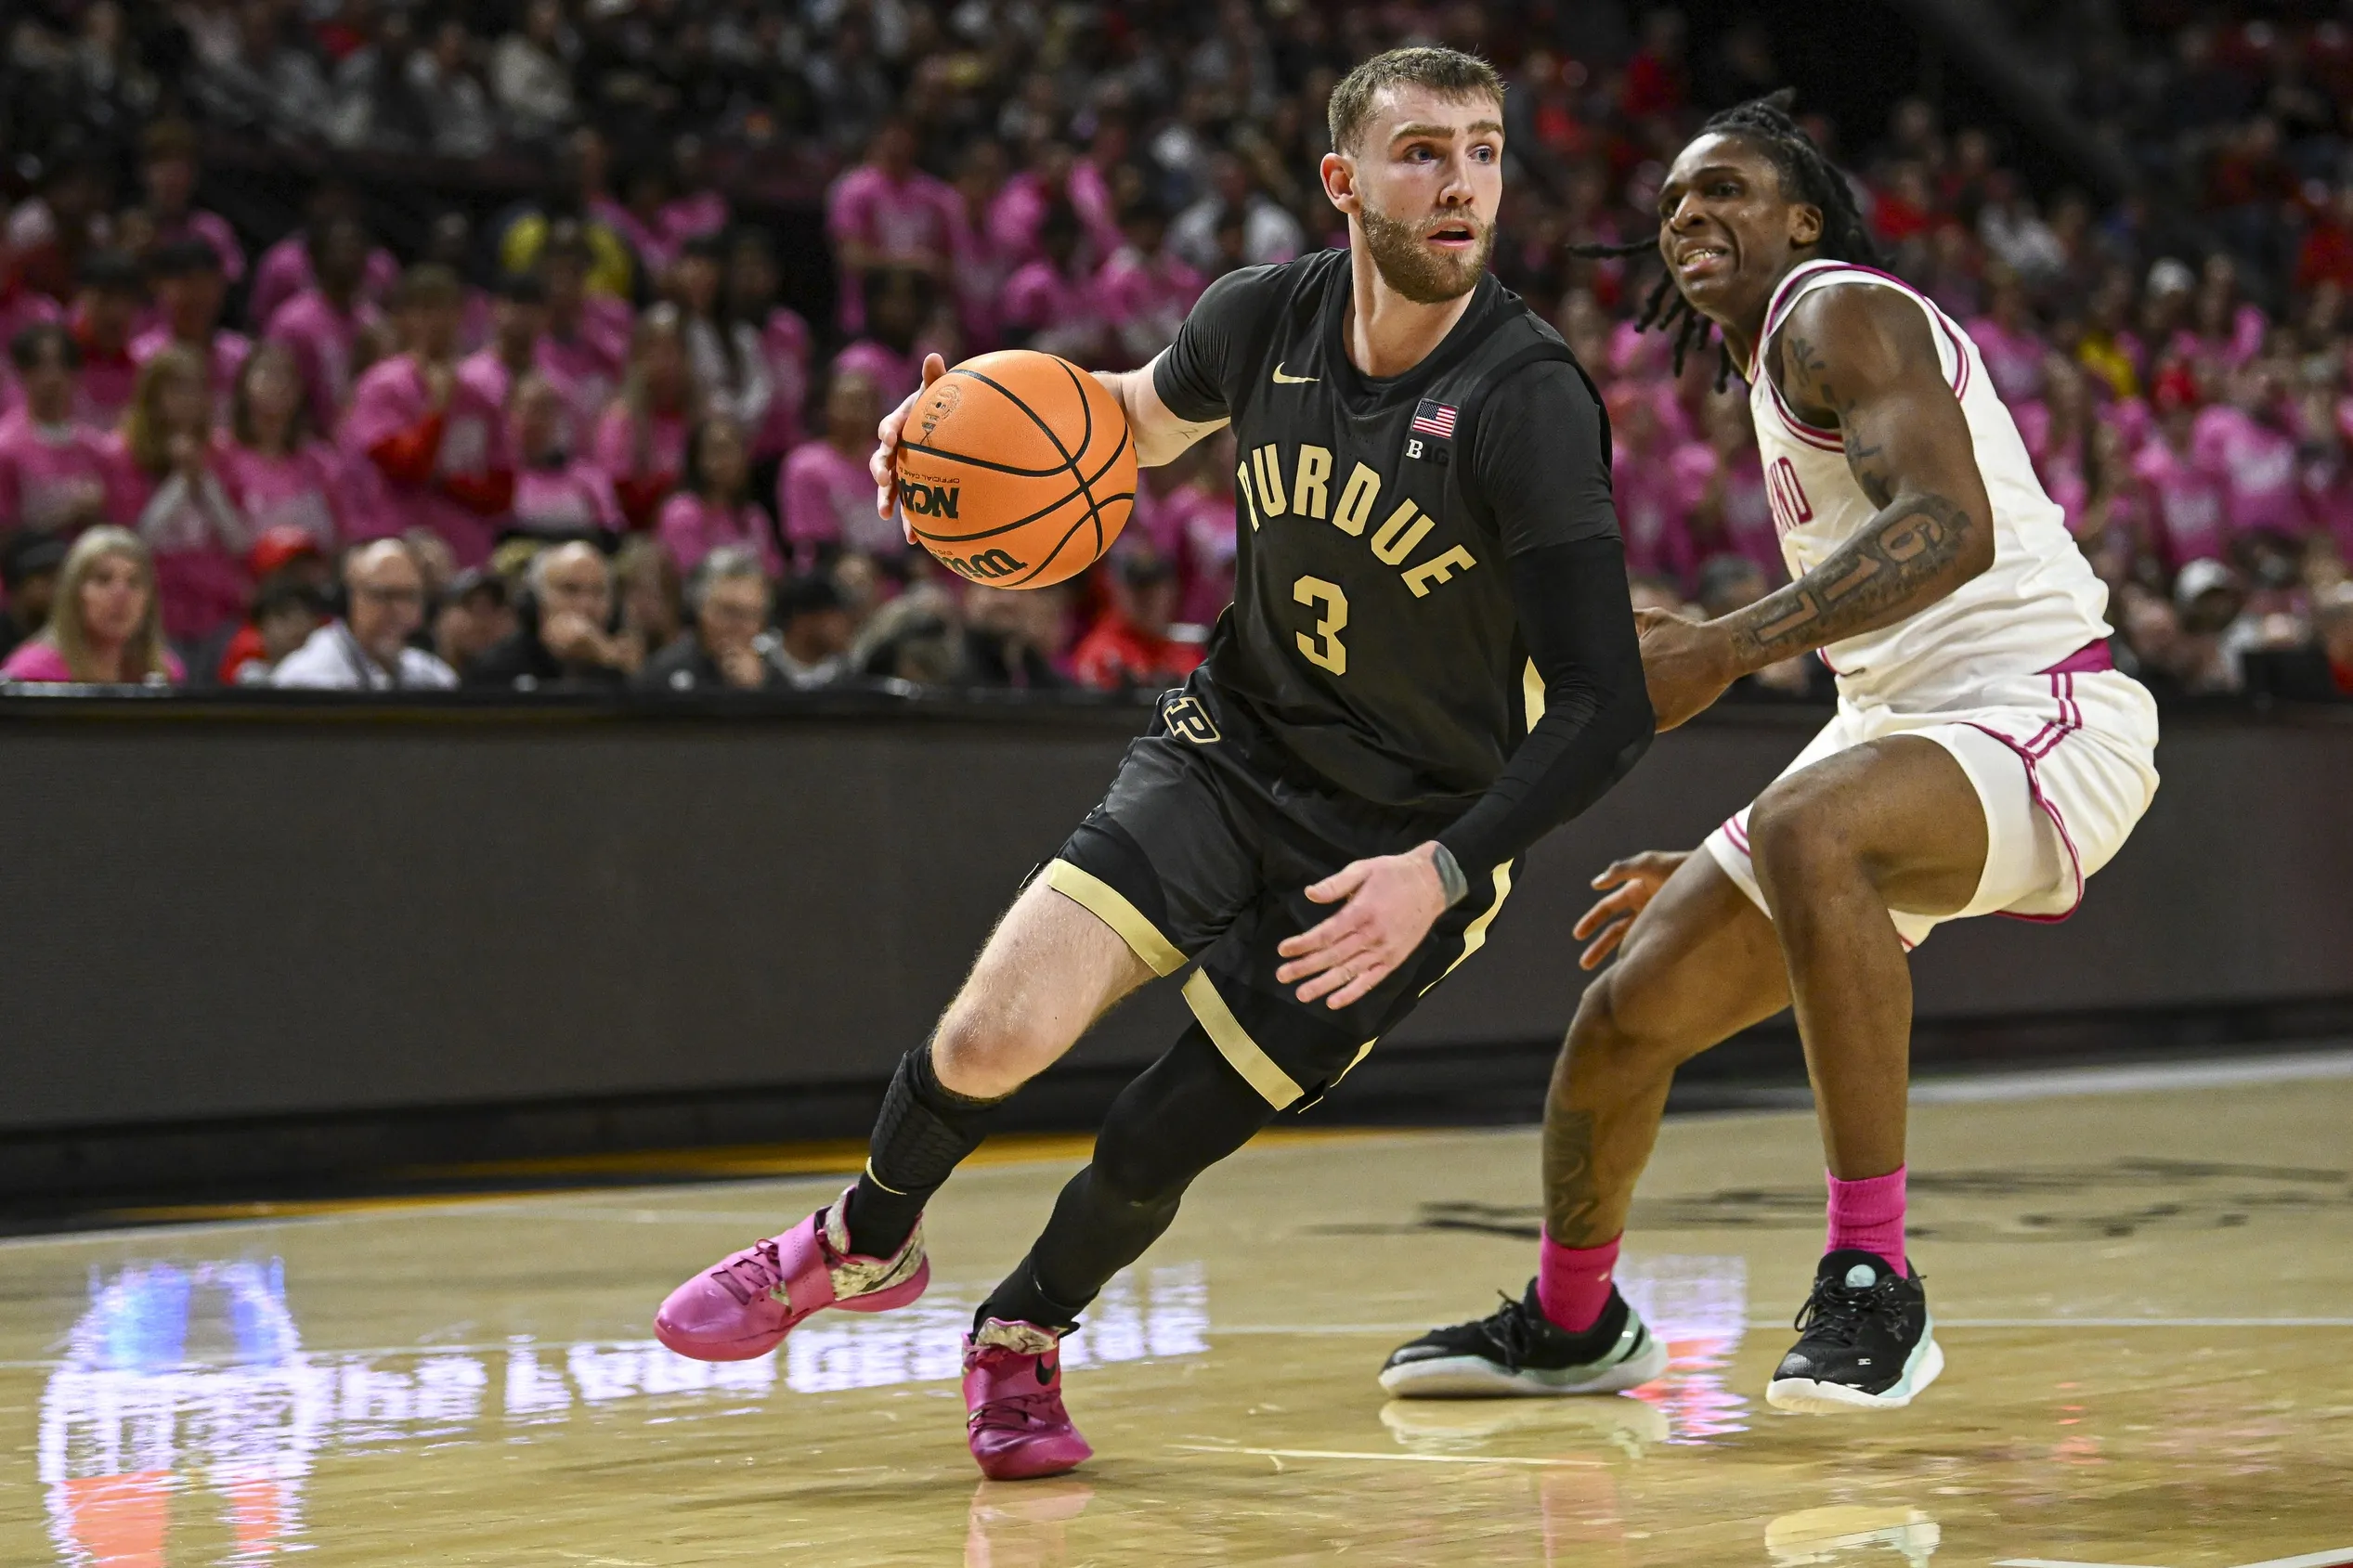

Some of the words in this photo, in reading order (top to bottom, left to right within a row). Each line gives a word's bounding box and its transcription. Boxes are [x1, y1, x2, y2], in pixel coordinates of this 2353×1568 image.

[1237, 443, 1477, 599] PURDUE
[1294, 575, 1348, 676] 3
[1163, 696, 1221, 744] P
